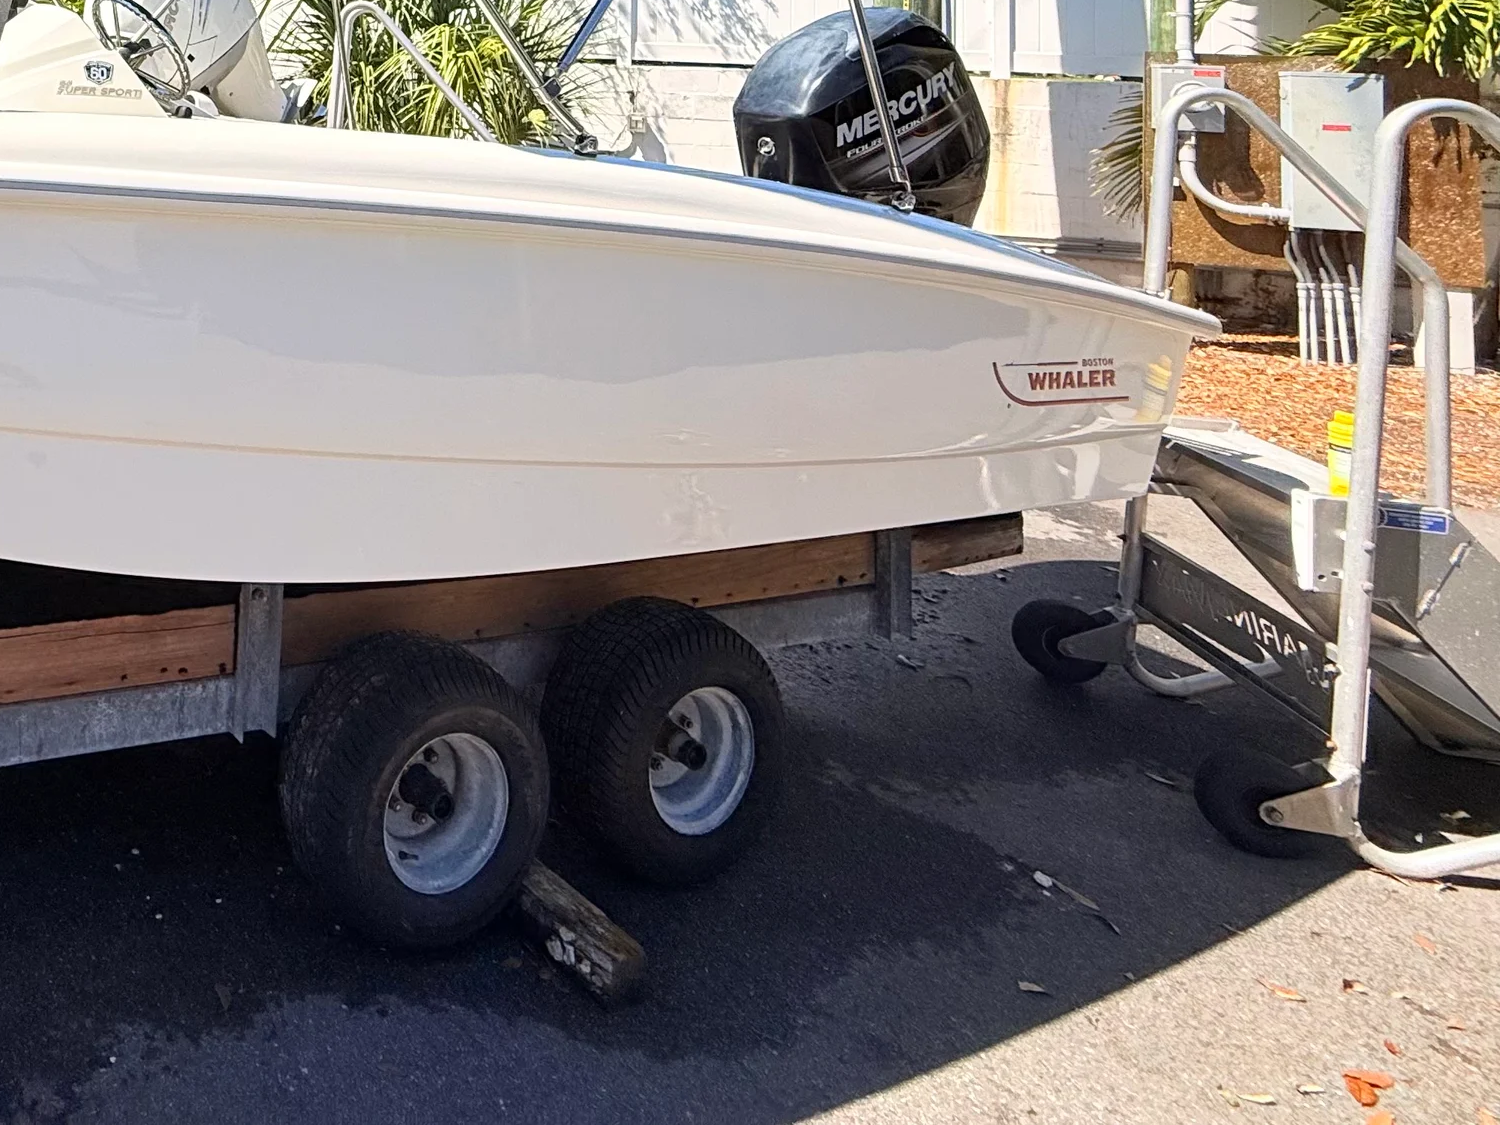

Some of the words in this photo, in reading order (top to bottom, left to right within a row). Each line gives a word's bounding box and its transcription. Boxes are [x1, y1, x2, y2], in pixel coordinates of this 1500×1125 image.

[90, 67, 107, 80] 60
[101, 87, 139, 98] SPORT
[836, 61, 956, 148] MERCURY
[1082, 358, 1114, 367] BOSTON
[1027, 369, 1116, 391] WHALER
